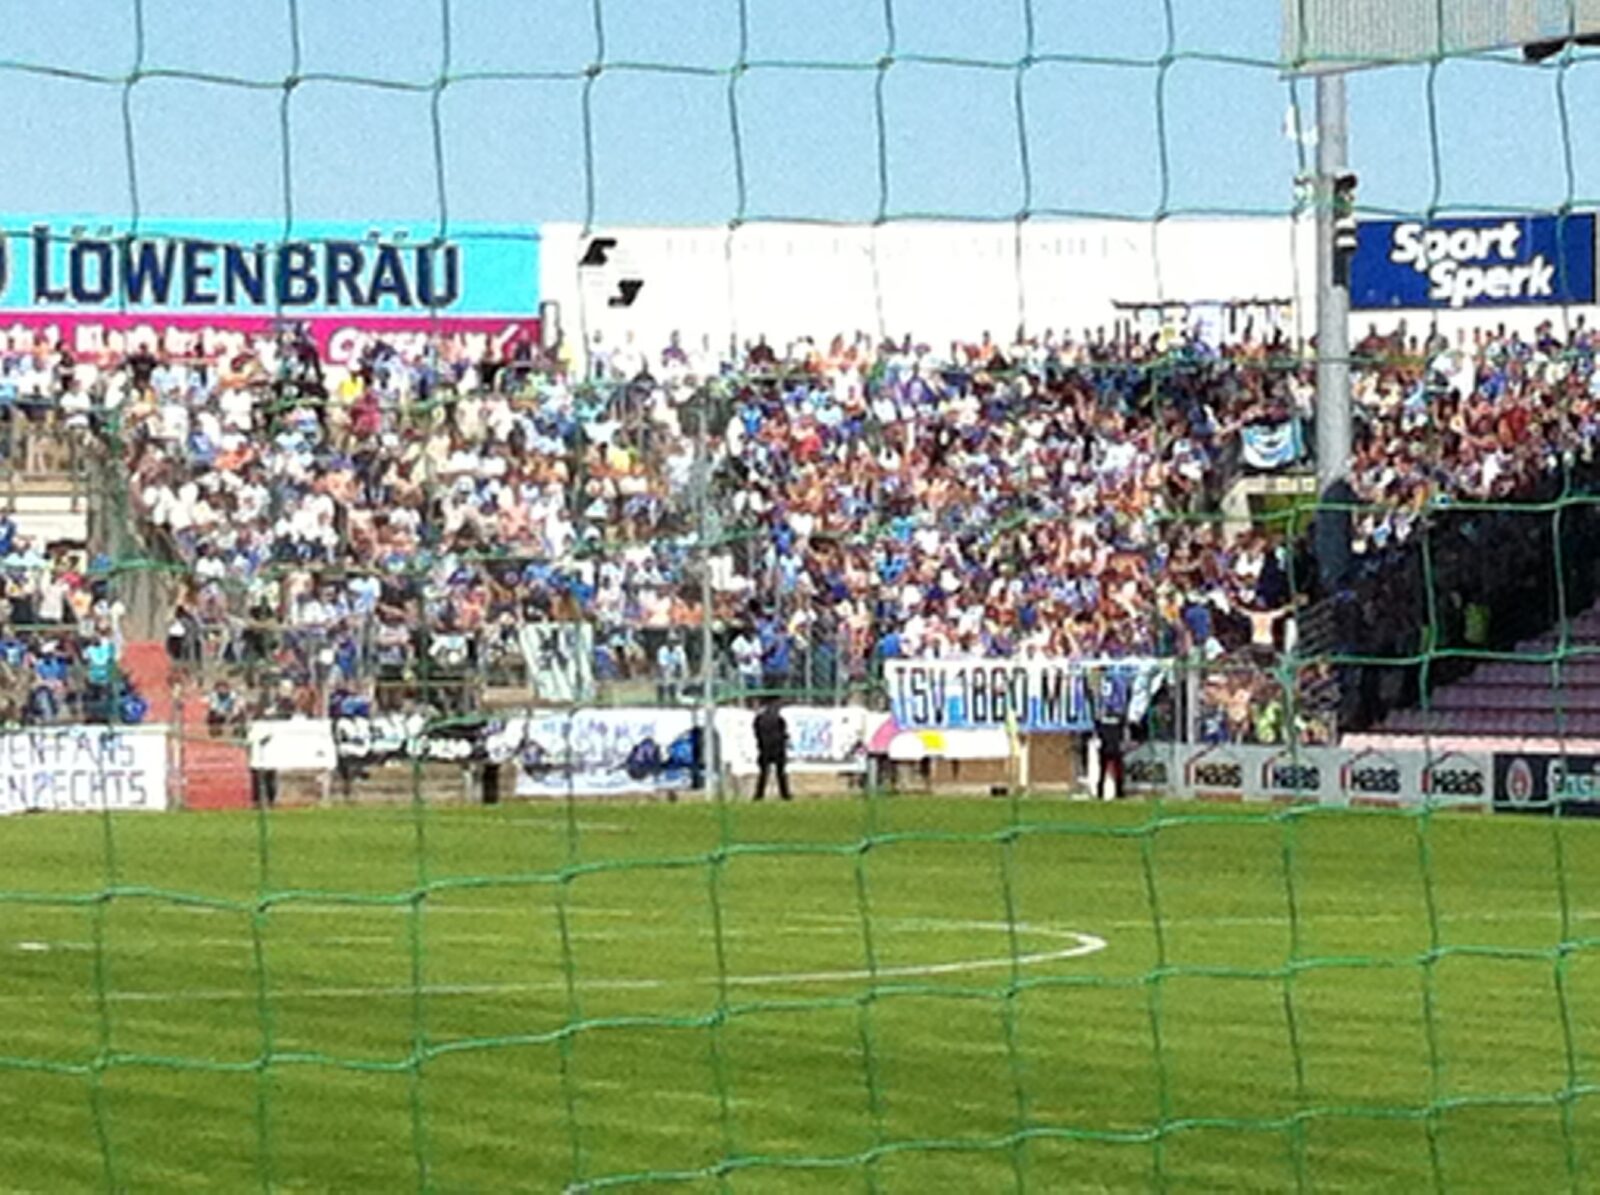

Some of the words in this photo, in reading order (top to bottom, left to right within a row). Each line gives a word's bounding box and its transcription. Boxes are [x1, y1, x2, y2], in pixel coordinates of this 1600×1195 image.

[33, 225, 458, 306] LÖWENBRÄU
[1391, 221, 1520, 272] Sport
[1430, 256, 1553, 307] Sperk
[895, 666, 947, 724] TSV
[956, 666, 1029, 722] 1860
